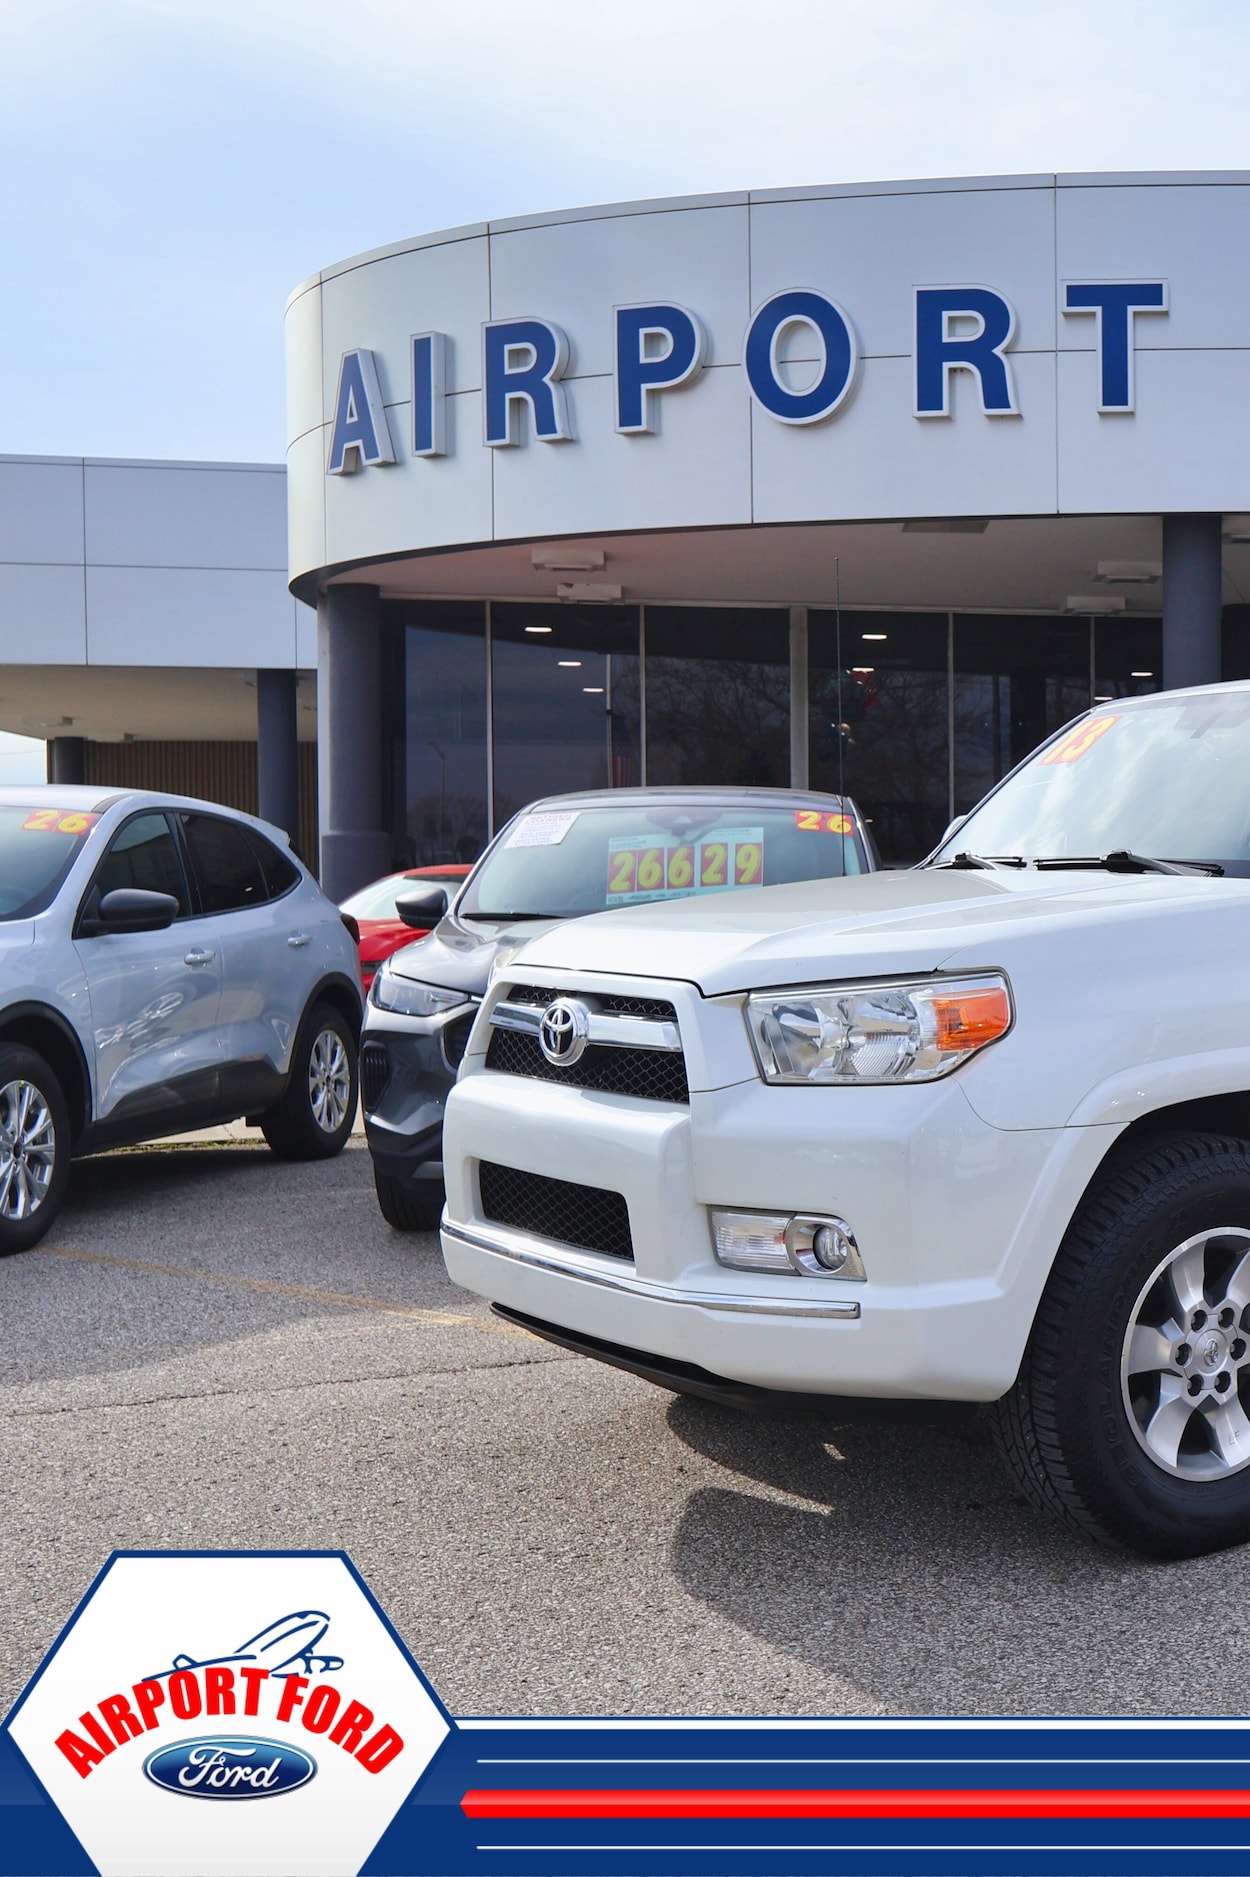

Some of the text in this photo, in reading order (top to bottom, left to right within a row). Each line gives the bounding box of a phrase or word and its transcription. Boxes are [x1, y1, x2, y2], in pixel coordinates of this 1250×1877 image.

[327, 278, 1169, 476] AIRPORT
[1042, 716, 1118, 764] 13
[24, 809, 91, 834] 26
[798, 810, 852, 834] 26
[608, 843, 763, 893] 26629
